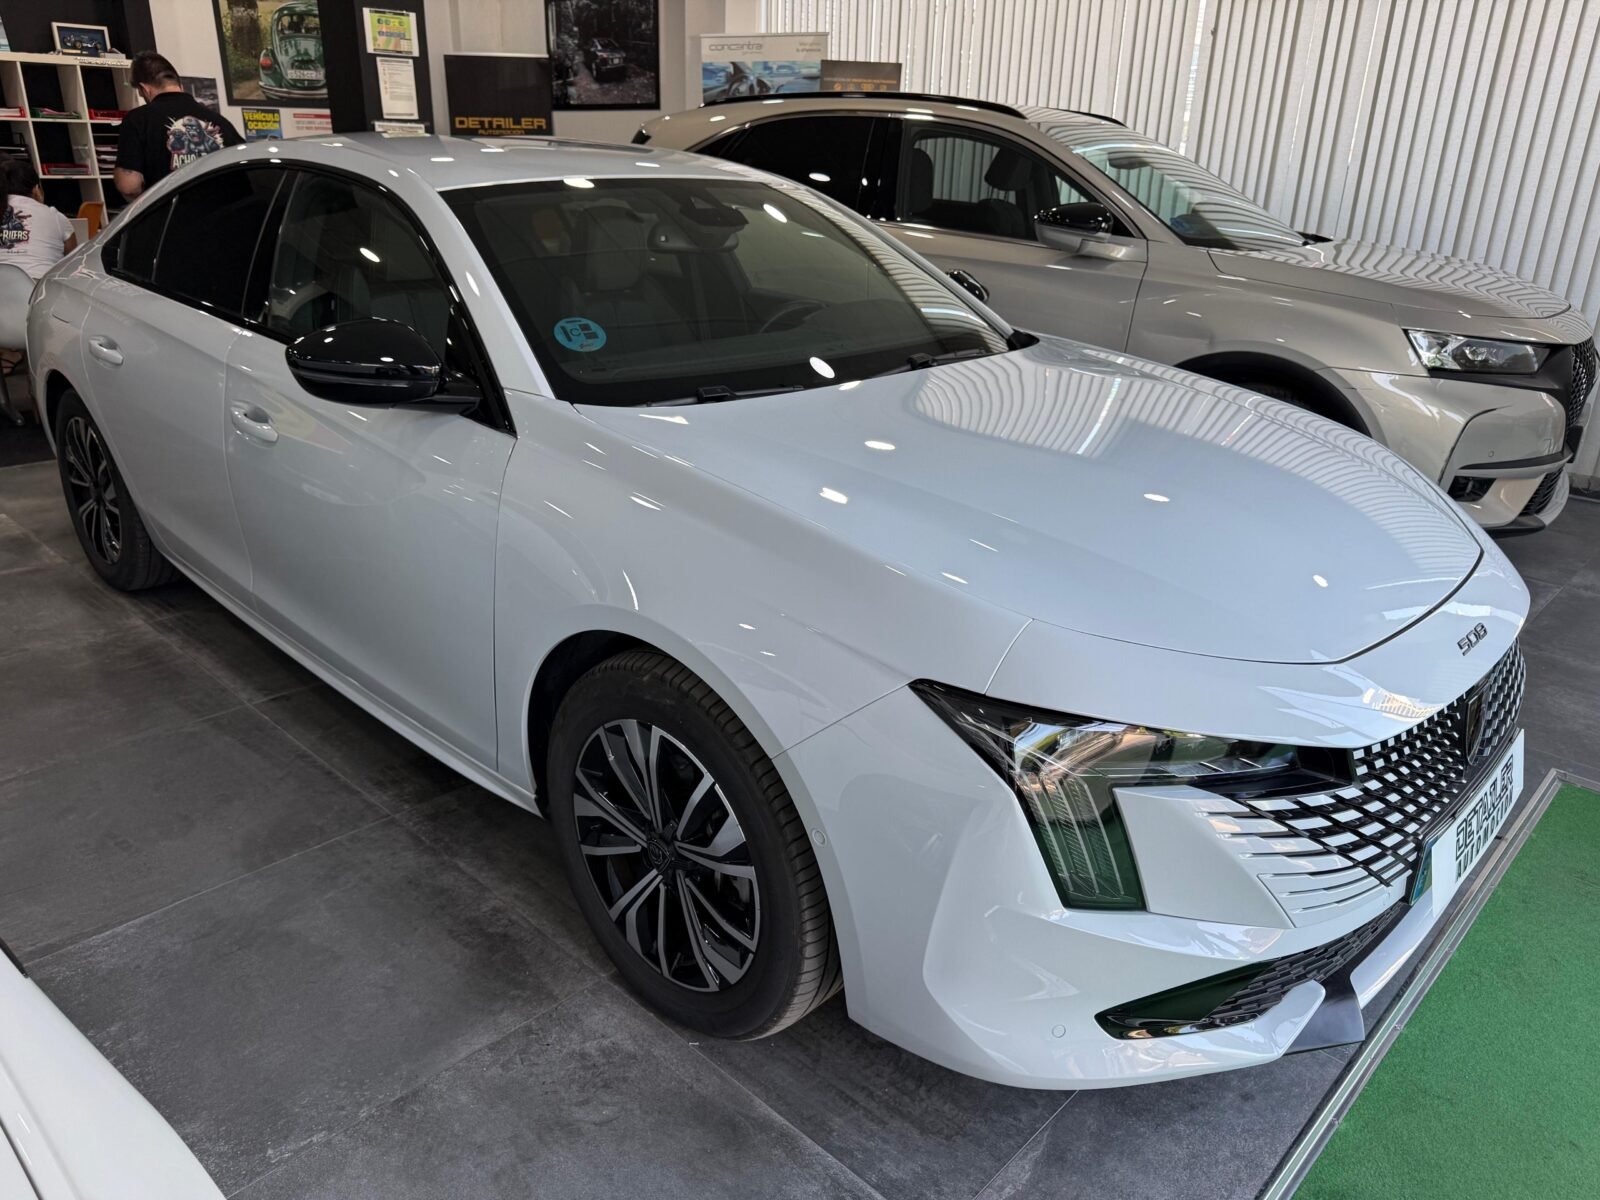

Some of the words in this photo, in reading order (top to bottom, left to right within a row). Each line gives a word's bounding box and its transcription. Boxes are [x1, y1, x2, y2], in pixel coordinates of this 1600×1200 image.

[455, 117, 546, 129] DETAILER
[1457, 622, 1488, 656] 508
[1456, 754, 1514, 861] DETAILER
